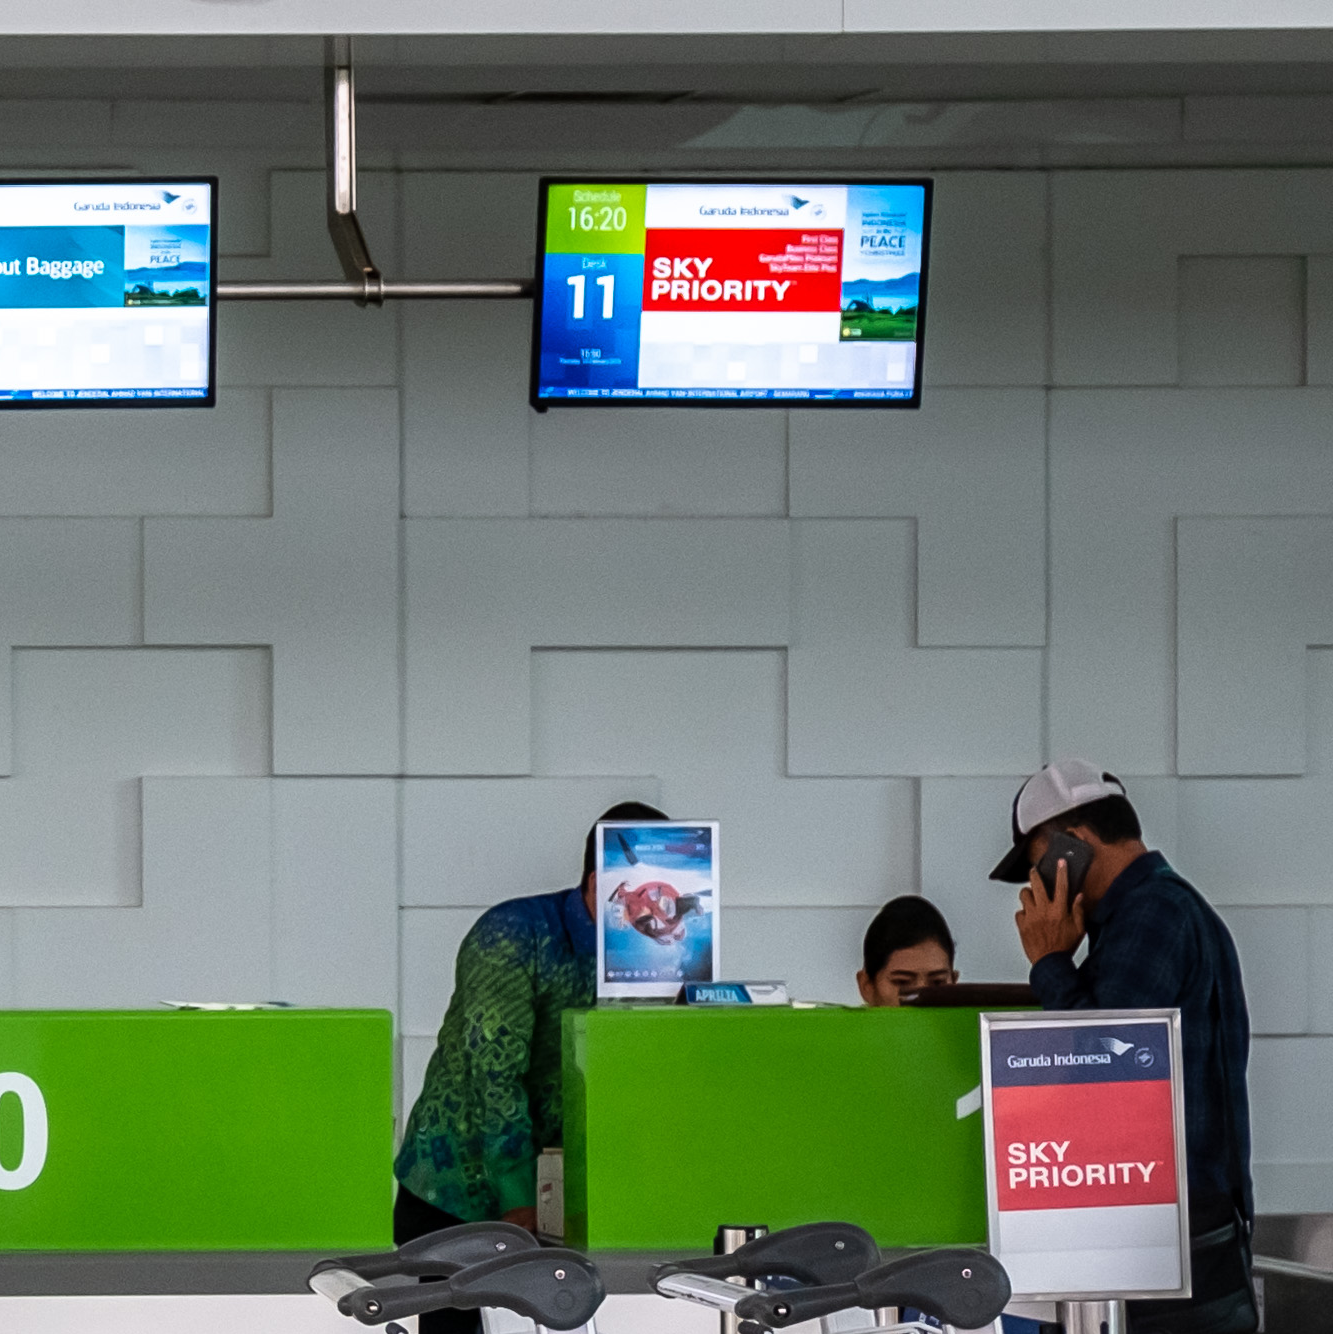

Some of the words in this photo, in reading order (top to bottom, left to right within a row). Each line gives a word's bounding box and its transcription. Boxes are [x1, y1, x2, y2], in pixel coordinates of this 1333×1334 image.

[568, 206, 627, 231] 16:20
[699, 205, 737, 216] Garuda
[860, 235, 905, 248] PEACE
[27, 257, 104, 279] Baggage
[652, 257, 712, 278] SKY
[567, 275, 615, 319] 11
[652, 280, 790, 301] PRIORITY
[1007, 1054, 1051, 1068] Garuda
[1054, 1053, 1111, 1067] Indonesia
[1008, 1141, 1071, 1165] SKY
[1009, 1161, 1157, 1189] PRIORITY
